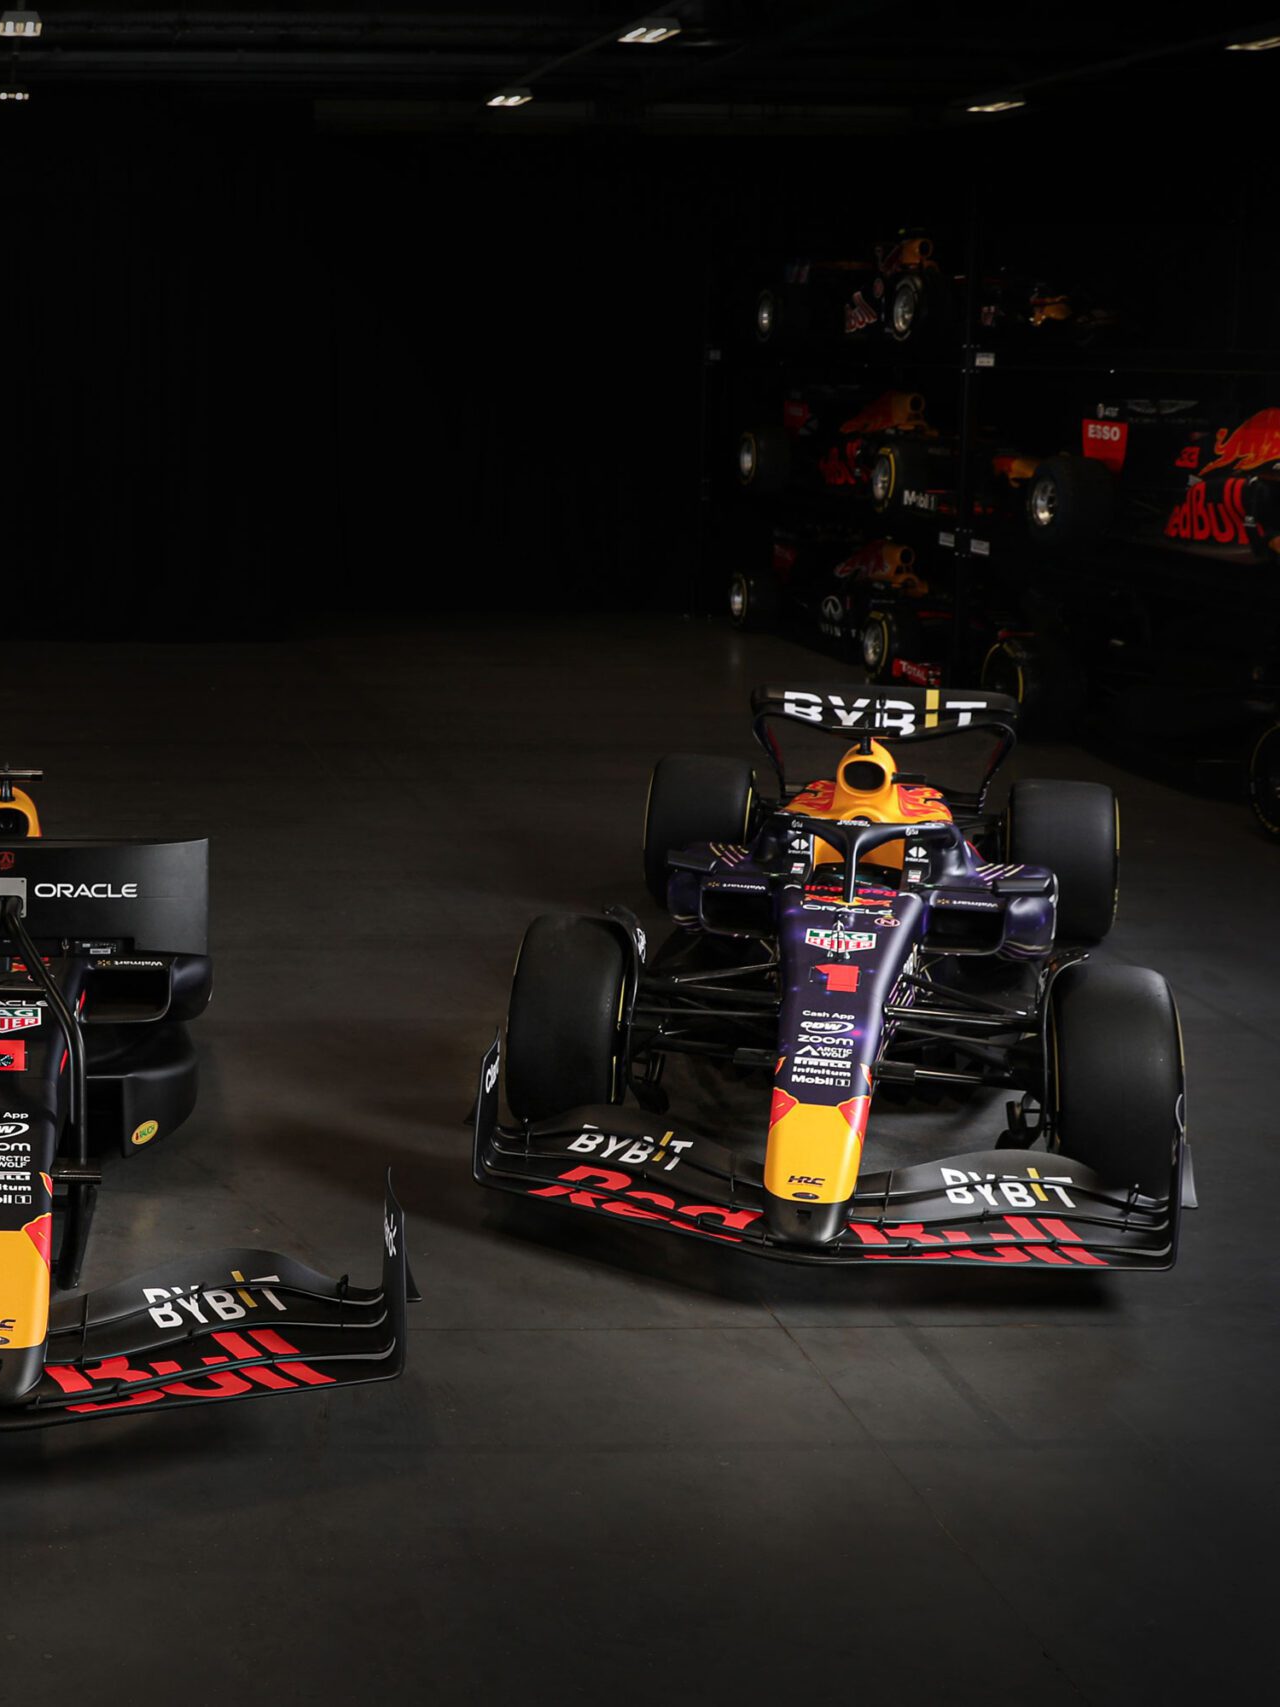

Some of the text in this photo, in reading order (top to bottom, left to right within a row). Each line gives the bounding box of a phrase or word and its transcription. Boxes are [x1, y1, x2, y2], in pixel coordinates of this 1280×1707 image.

[1087, 424, 1121, 441] ESSO
[783, 689, 987, 736] BYBIT
[34, 883, 138, 899] ORACLE
[802, 904, 894, 916] ORACLE
[814, 963, 860, 993] 1
[802, 1010, 855, 1020] Cash App
[817, 1046, 853, 1055] ARCTIC
[791, 1074, 834, 1086] Mobil
[2, 1112, 29, 1120] App
[567, 1127, 693, 1172] BYBIT
[788, 1176, 825, 1186] HRC
[940, 1167, 1076, 1209] BYBIT
[527, 1164, 765, 1243] Red
[849, 1215, 1109, 1266] Bull
[142, 1270, 288, 1329] BYBIT
[44, 1328, 337, 1414] Bull
